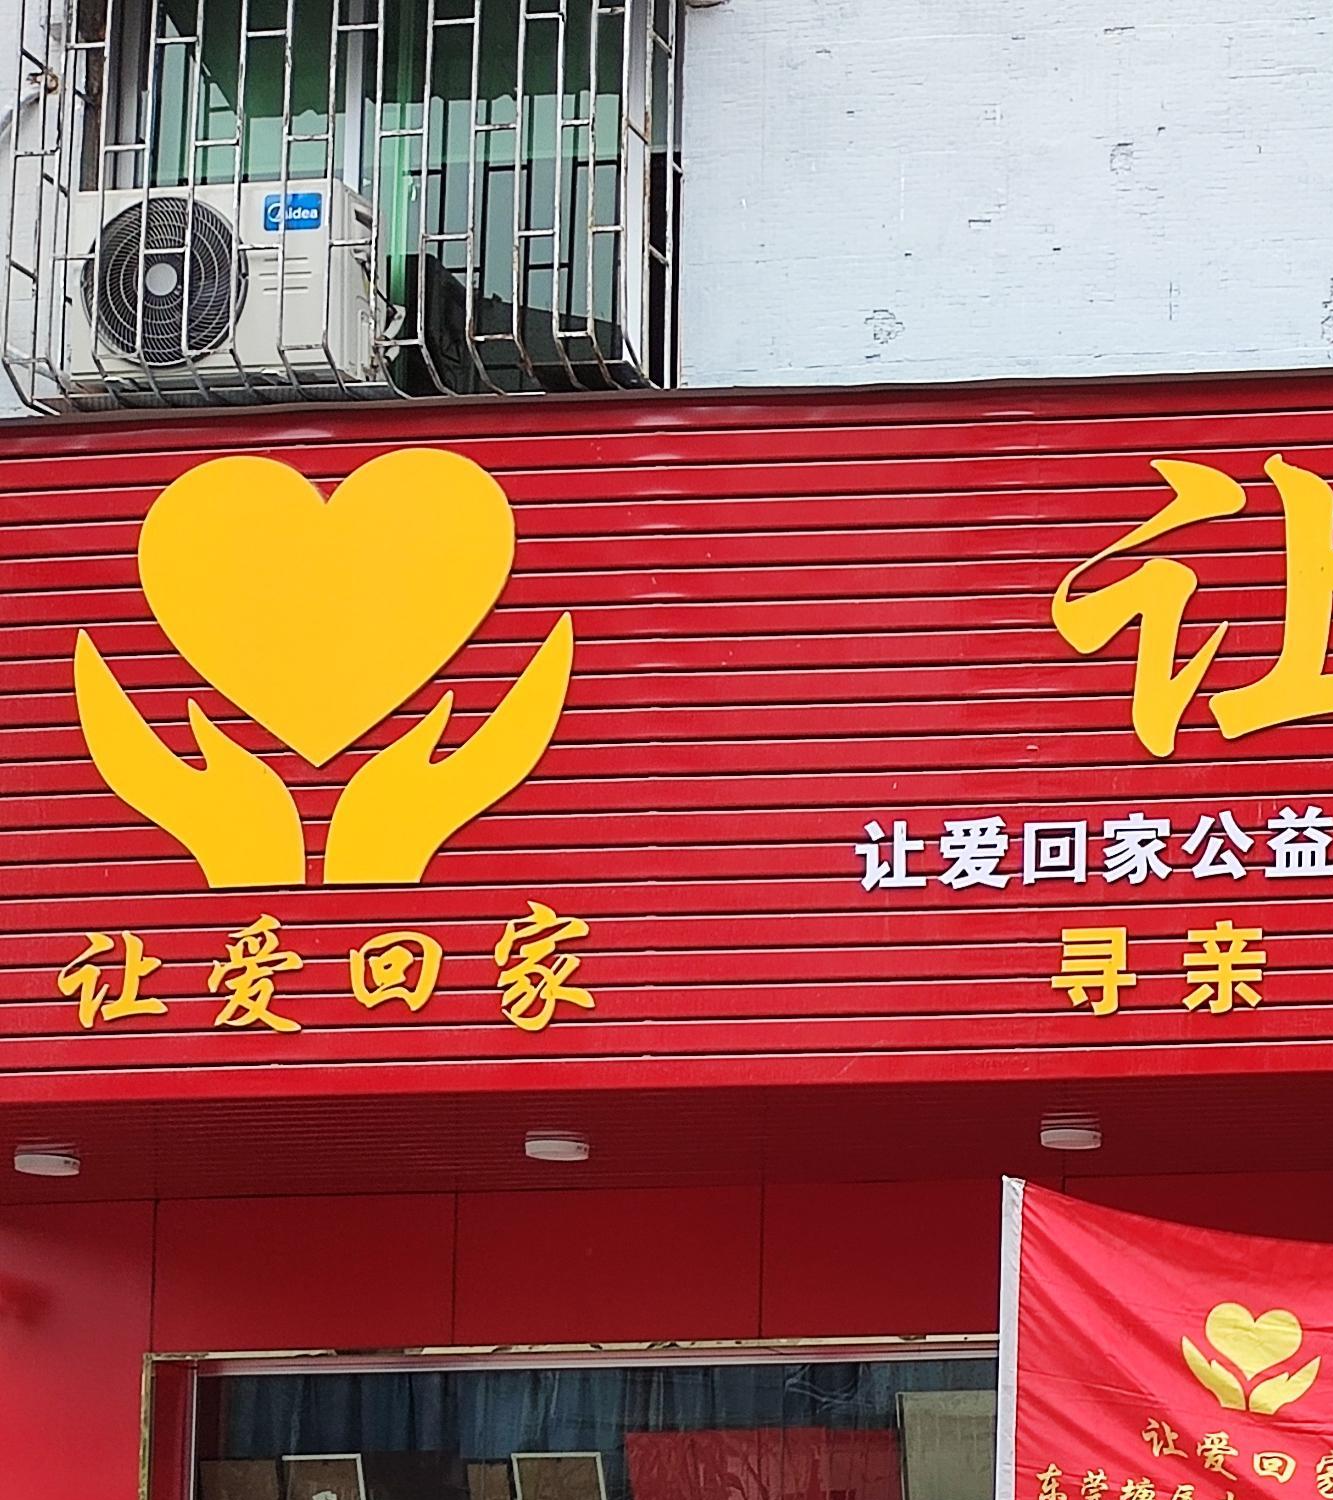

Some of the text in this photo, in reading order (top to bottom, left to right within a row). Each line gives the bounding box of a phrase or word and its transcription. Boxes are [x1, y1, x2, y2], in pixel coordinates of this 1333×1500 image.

[58, 902, 596, 1032] 让爱回家
[1052, 918, 1268, 1015] 寻亲
